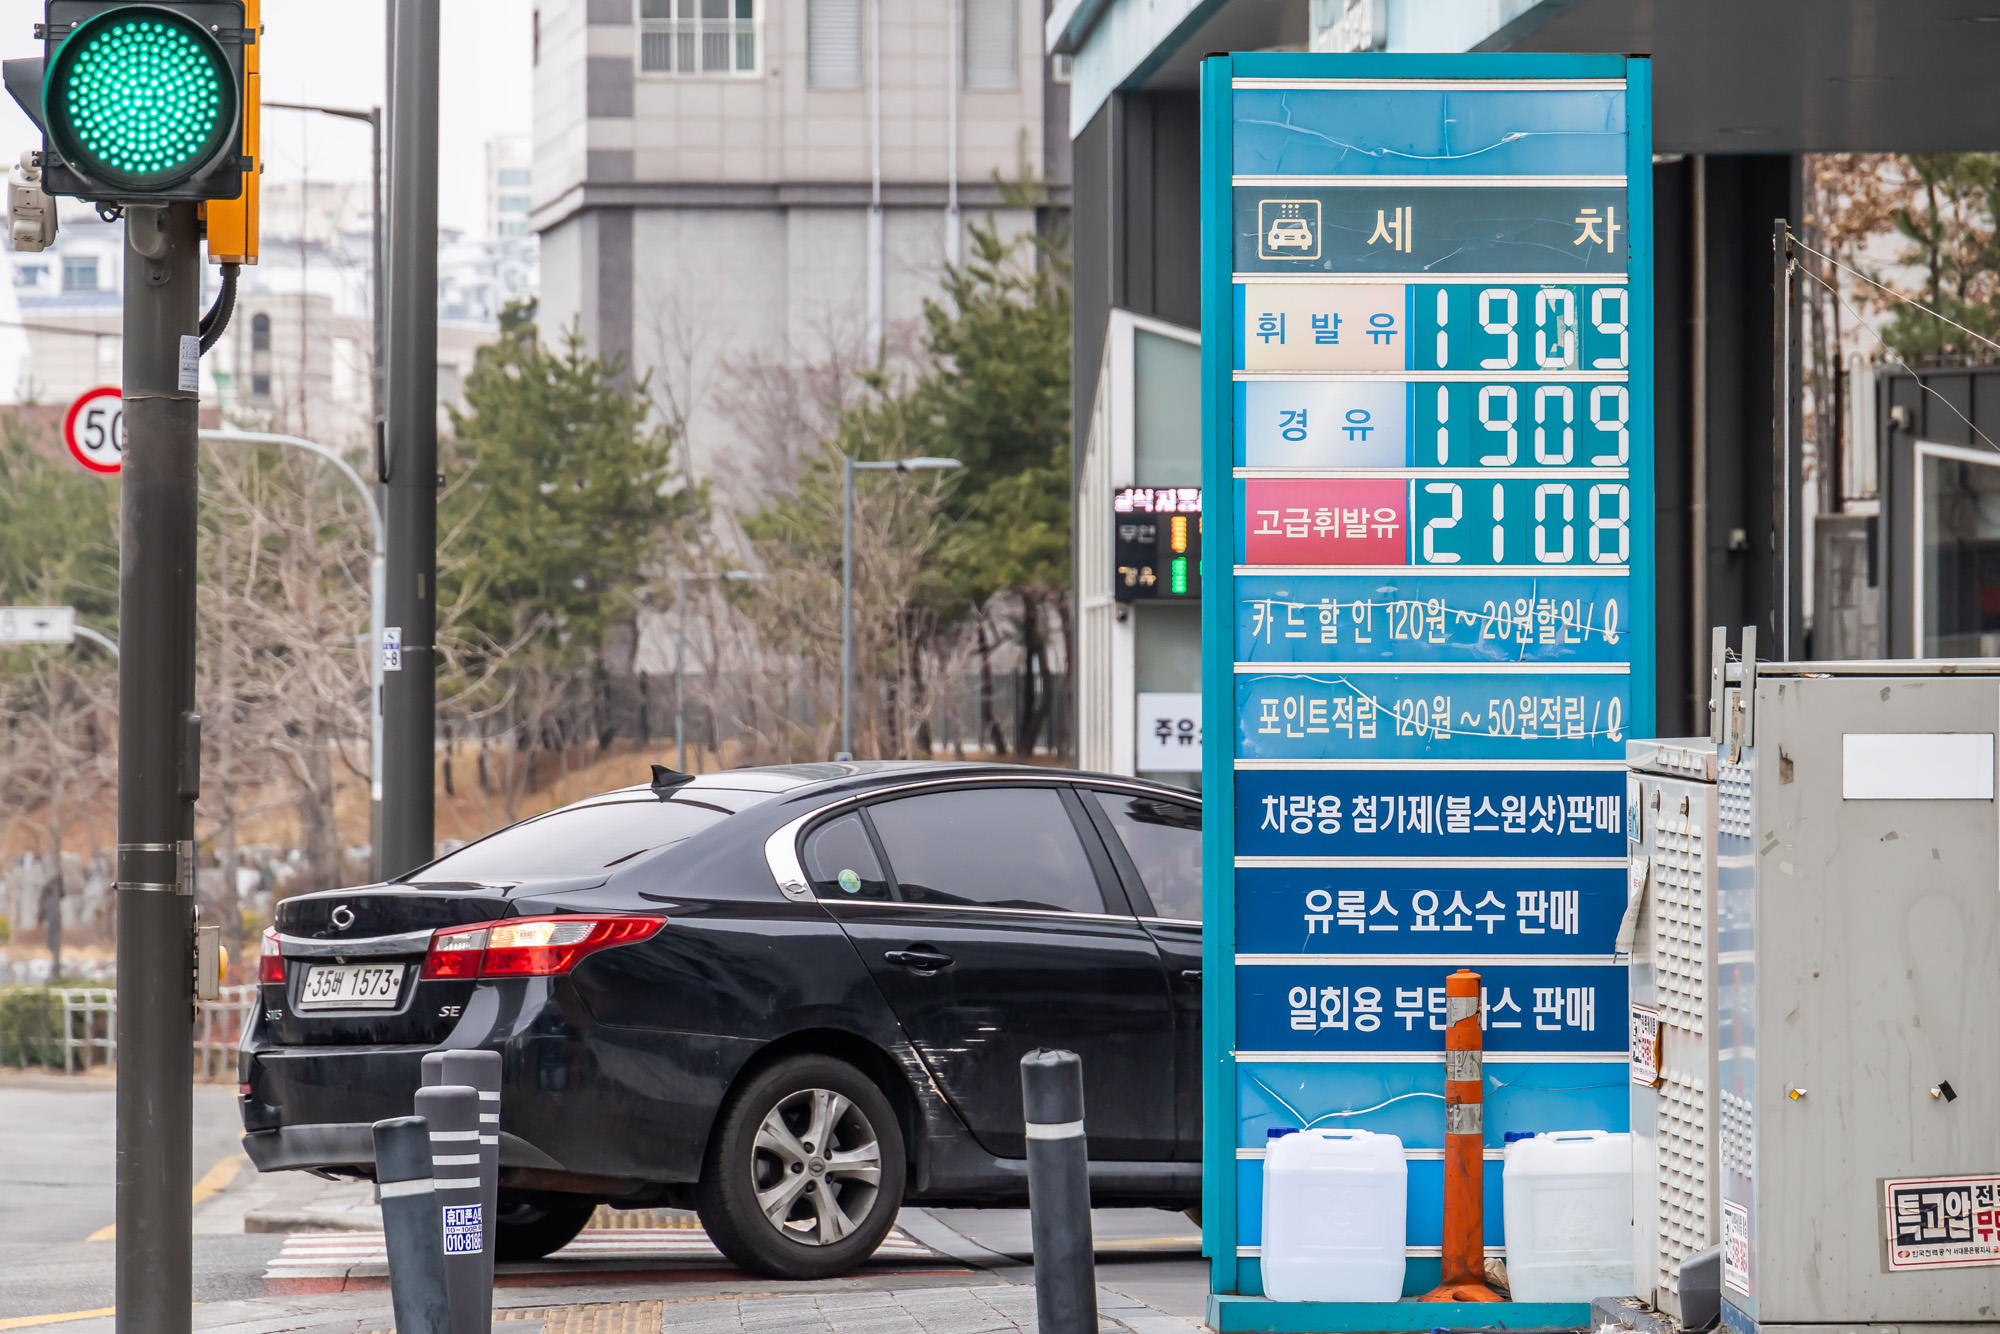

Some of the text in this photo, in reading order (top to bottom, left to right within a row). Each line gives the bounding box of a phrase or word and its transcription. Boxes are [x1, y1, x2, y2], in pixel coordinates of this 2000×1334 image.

[1436, 287, 1629, 370] 1909
[1436, 384, 1630, 467] 1909
[1253, 482, 1630, 564] 고급휘발유 2108
[1386, 598, 1447, 644] 120원
[1155, 718, 1202, 746] 주유
[1258, 696, 1377, 739] 포인트적립
[1393, 696, 1452, 740] 120원
[1260, 794, 1343, 835] 차량용
[1303, 889, 1580, 935] 유록스 요소수 판매
[351, 968, 394, 996] 1573
[438, 1005, 462, 1018] SE
[1287, 985, 1384, 1032] 일회용
[1532, 985, 1596, 1032] 판매
[1975, 1184, 2000, 1208] 전
